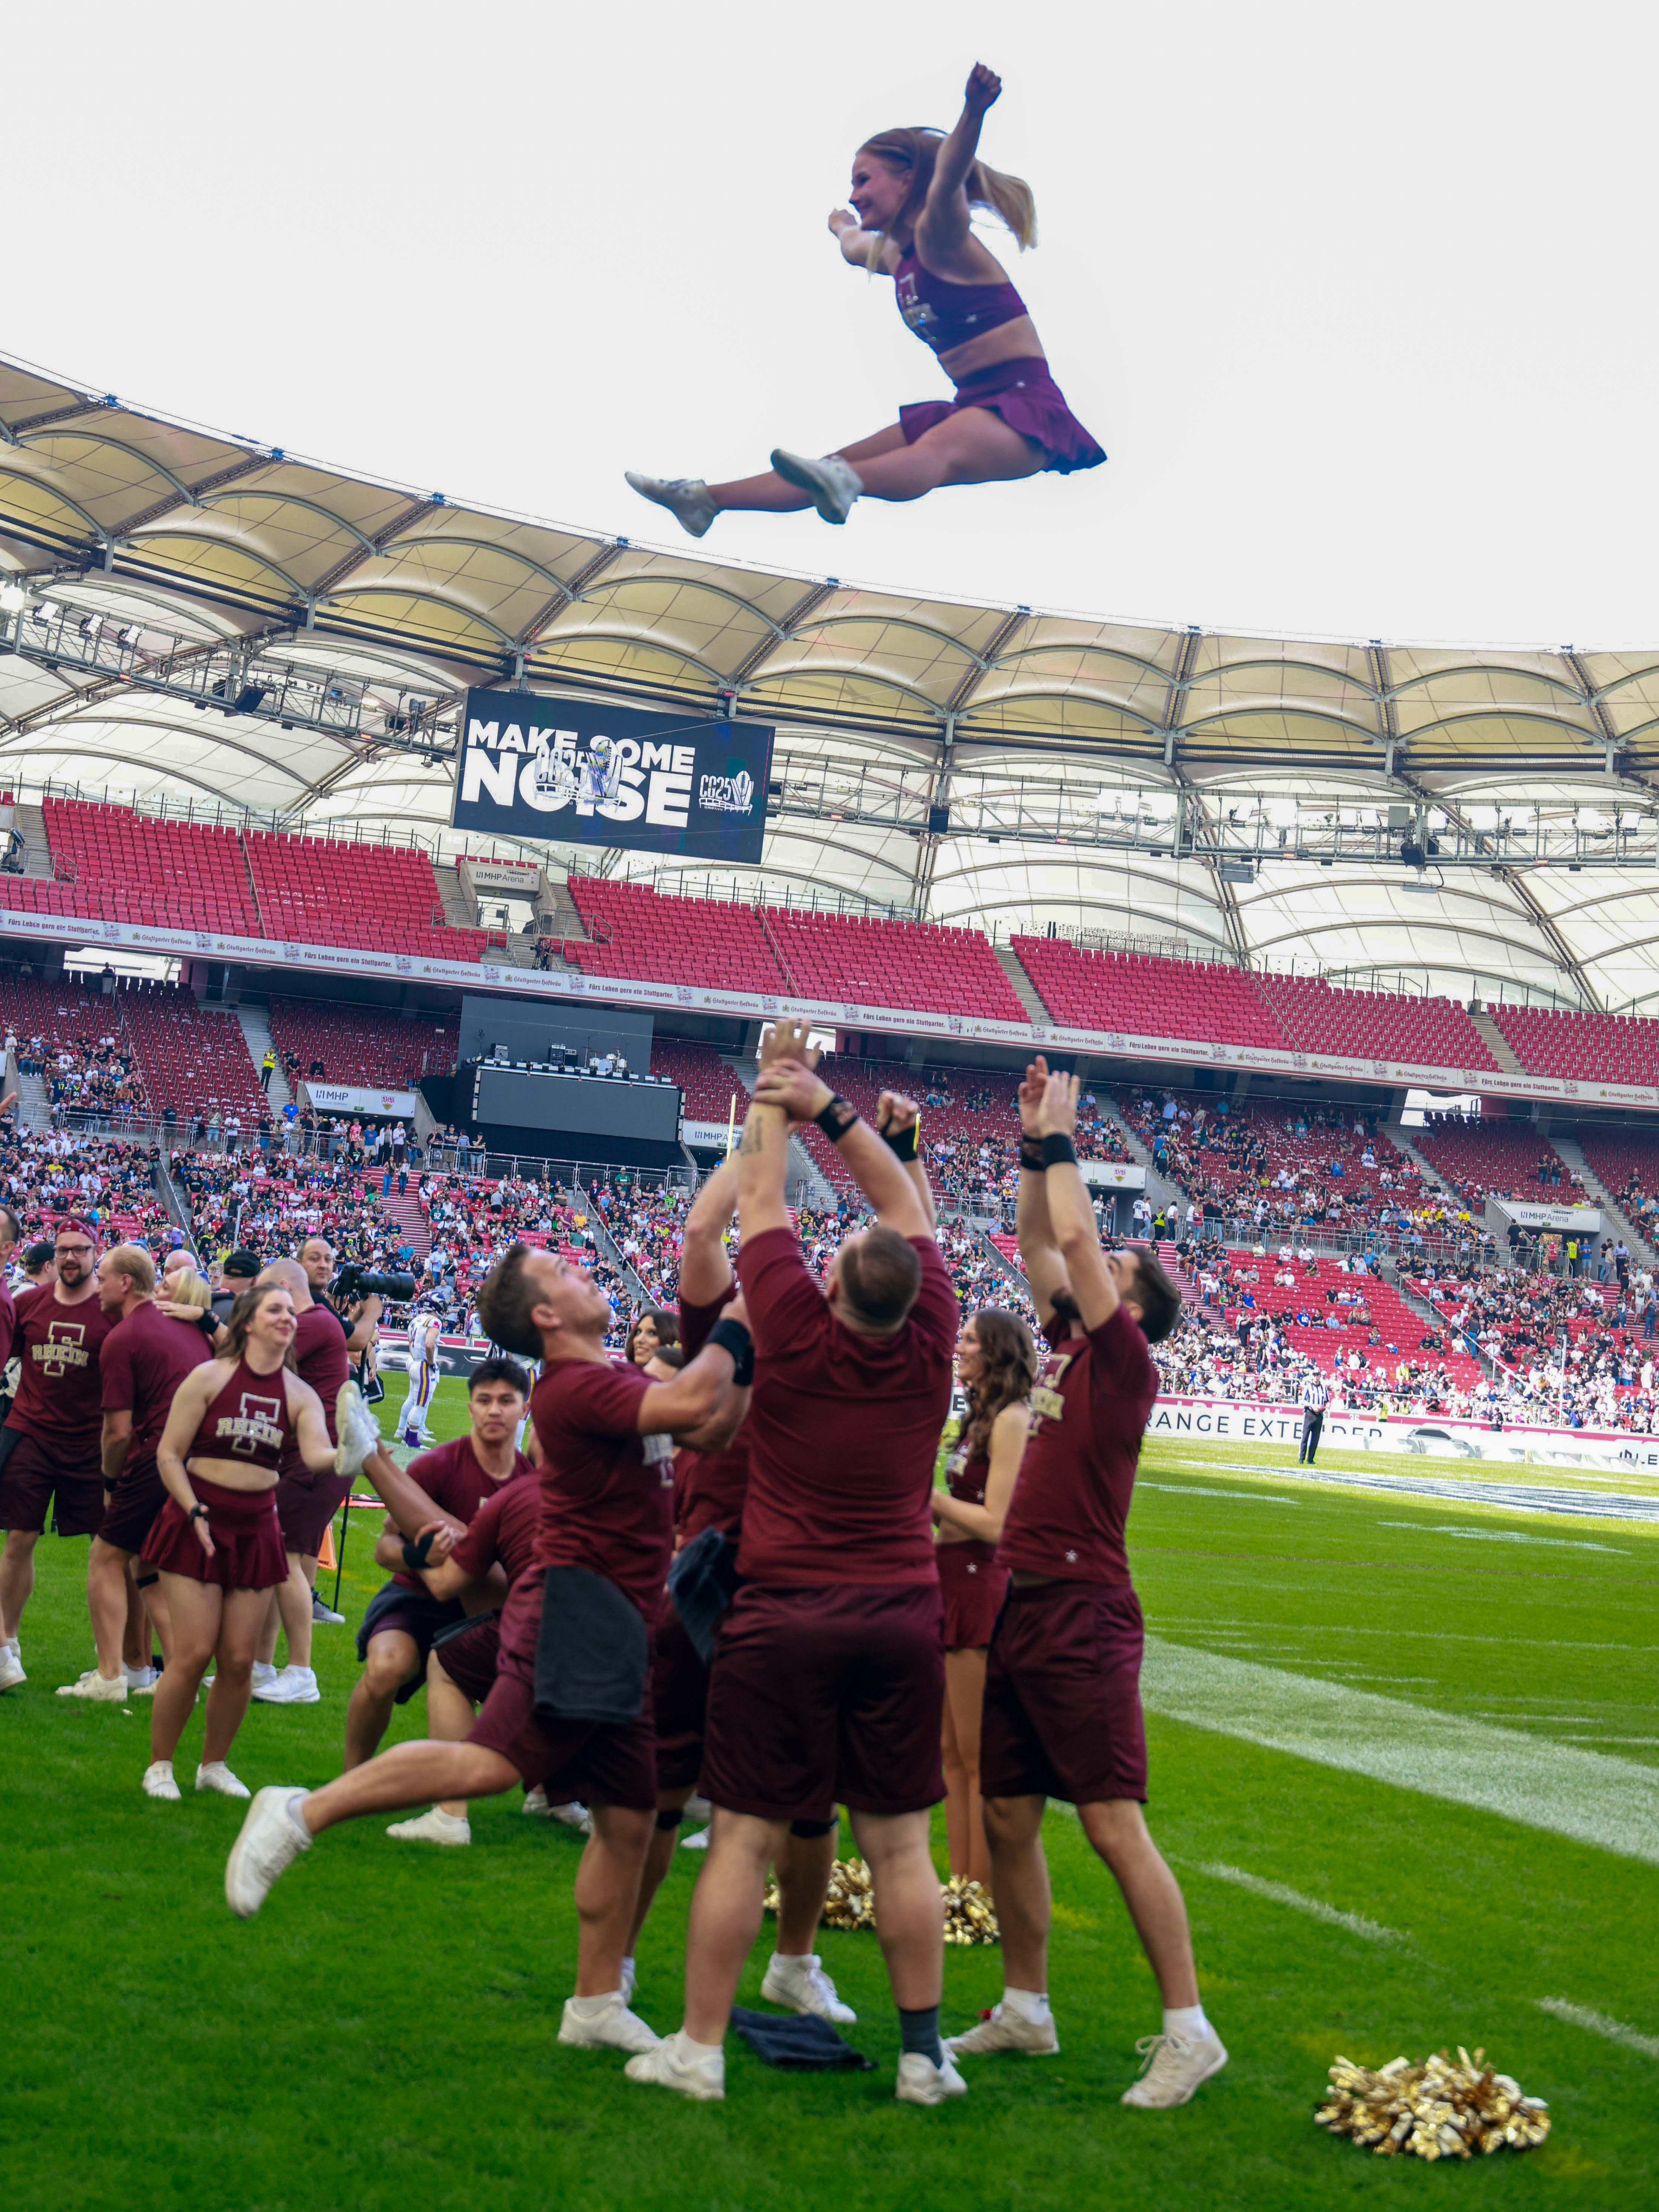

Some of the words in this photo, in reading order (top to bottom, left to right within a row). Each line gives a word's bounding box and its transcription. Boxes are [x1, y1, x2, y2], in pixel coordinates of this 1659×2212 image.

[468, 719, 578, 753] MAKE
[461, 749, 691, 828] NOSE
[700, 775, 731, 801] CG25
[327, 1091, 349, 1101] MHP
[32, 1344, 89, 1367] RHEIN
[216, 1417, 284, 1450] RHEIN
